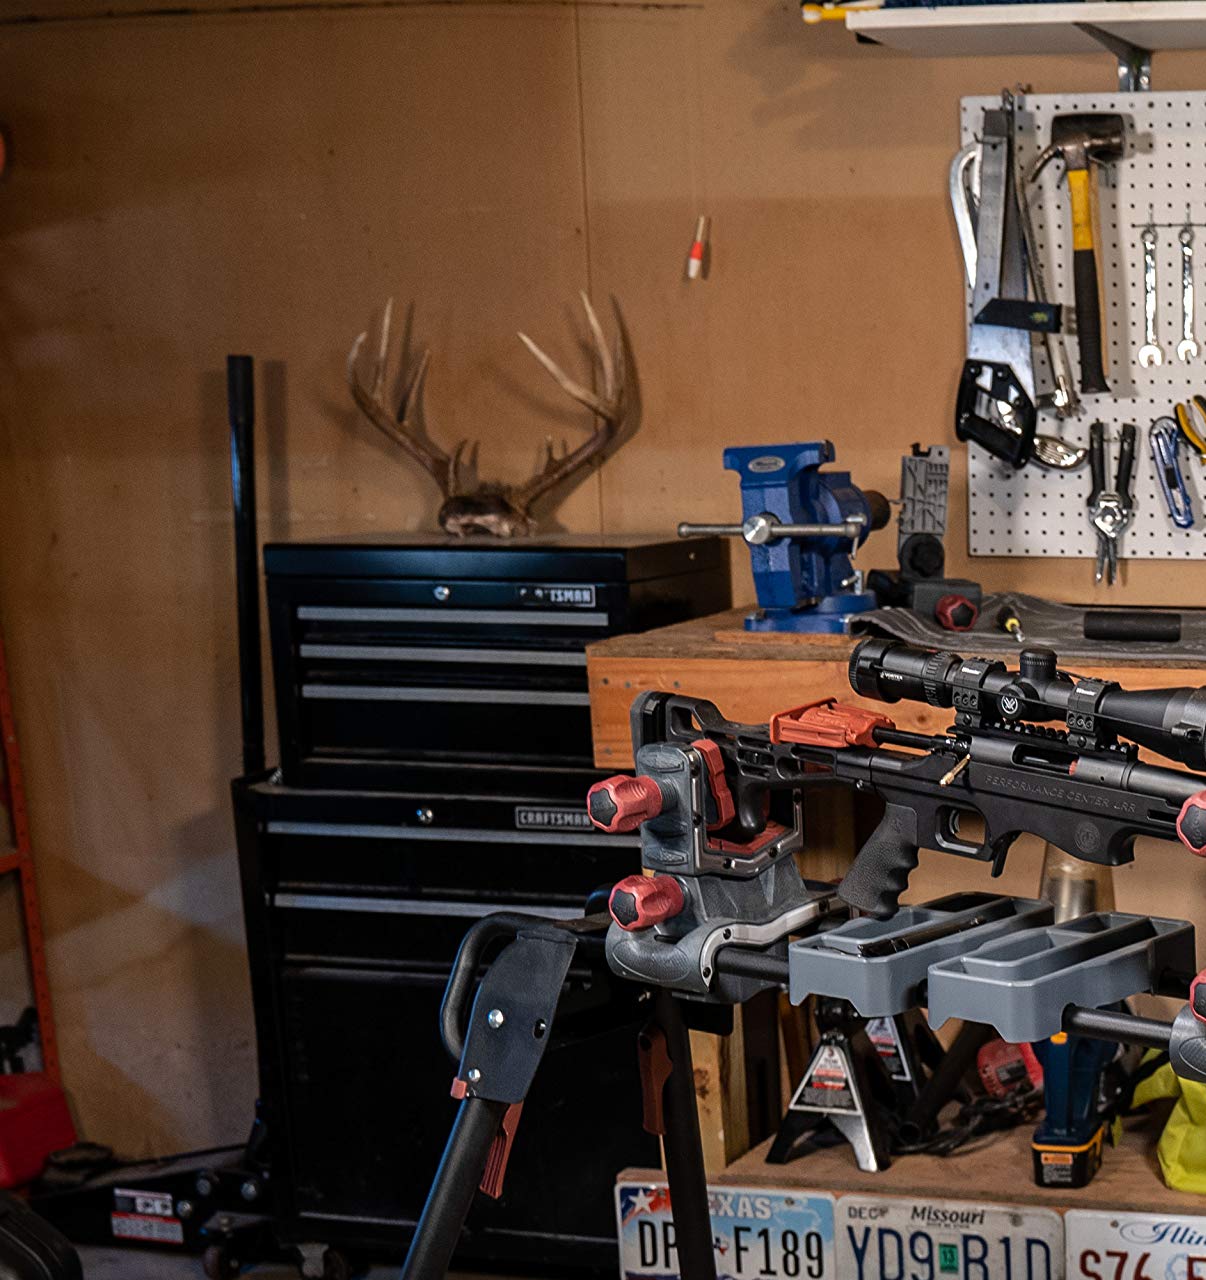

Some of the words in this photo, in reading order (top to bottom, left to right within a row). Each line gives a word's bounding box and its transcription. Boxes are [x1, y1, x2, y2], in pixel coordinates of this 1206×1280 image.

[984, 775, 1065, 800] PERFORMANCE
[1067, 791, 1110, 808] CENTER
[520, 811, 590, 826] CRAFTSMAN
[911, 1206, 985, 1225] Missouri
[733, 1225, 824, 1279] F189
